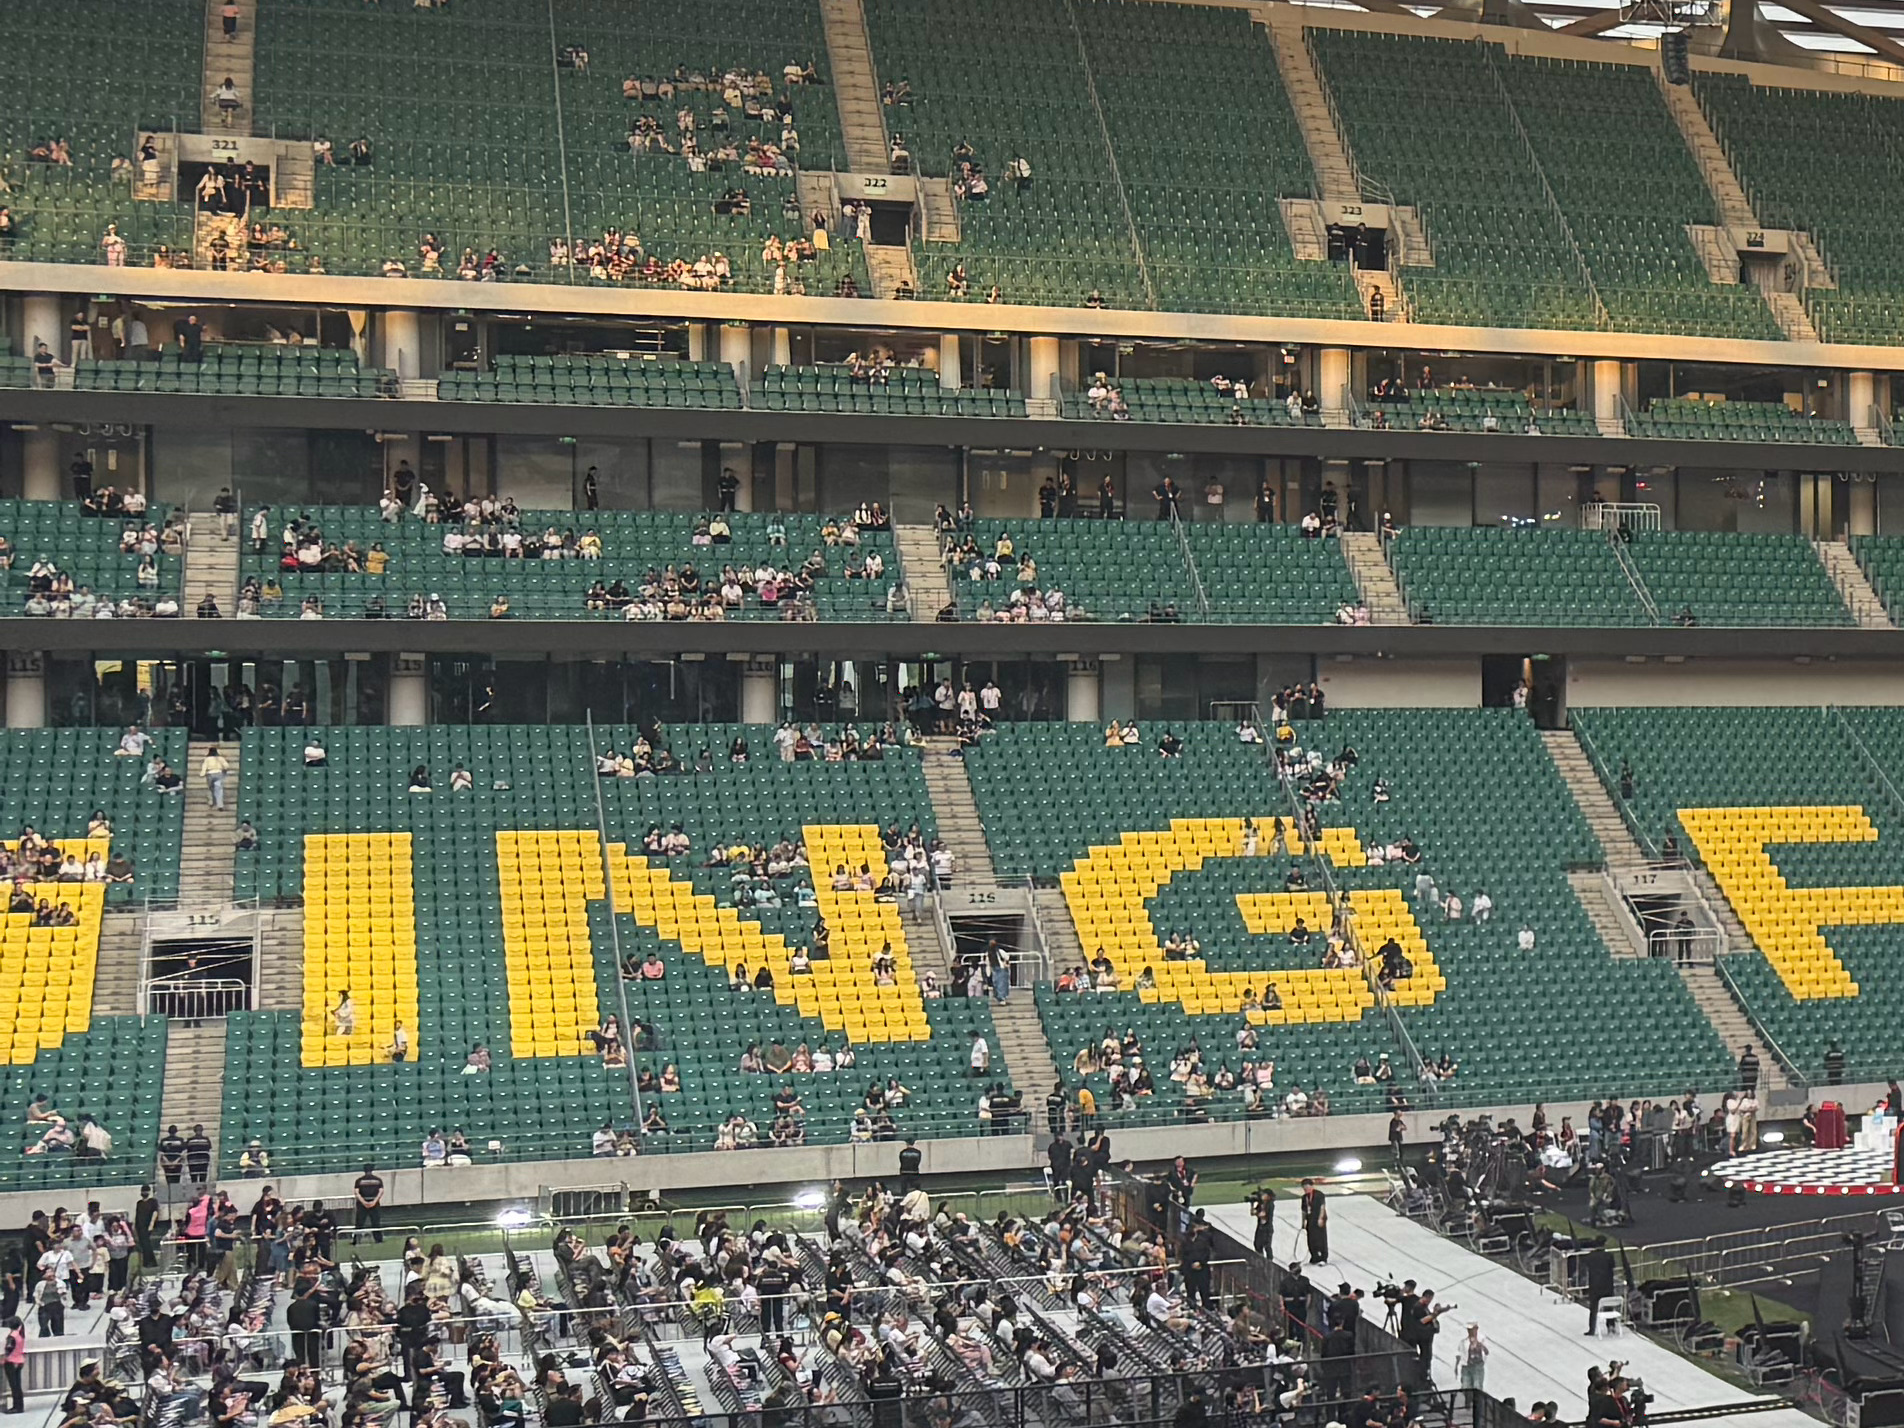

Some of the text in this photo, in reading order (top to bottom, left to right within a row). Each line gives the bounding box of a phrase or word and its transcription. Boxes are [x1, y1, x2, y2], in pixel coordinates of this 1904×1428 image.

[212, 139, 239, 151] 321
[864, 178, 887, 188] 322
[1341, 205, 1362, 216] 323
[1634, 874, 1658, 885] 117
